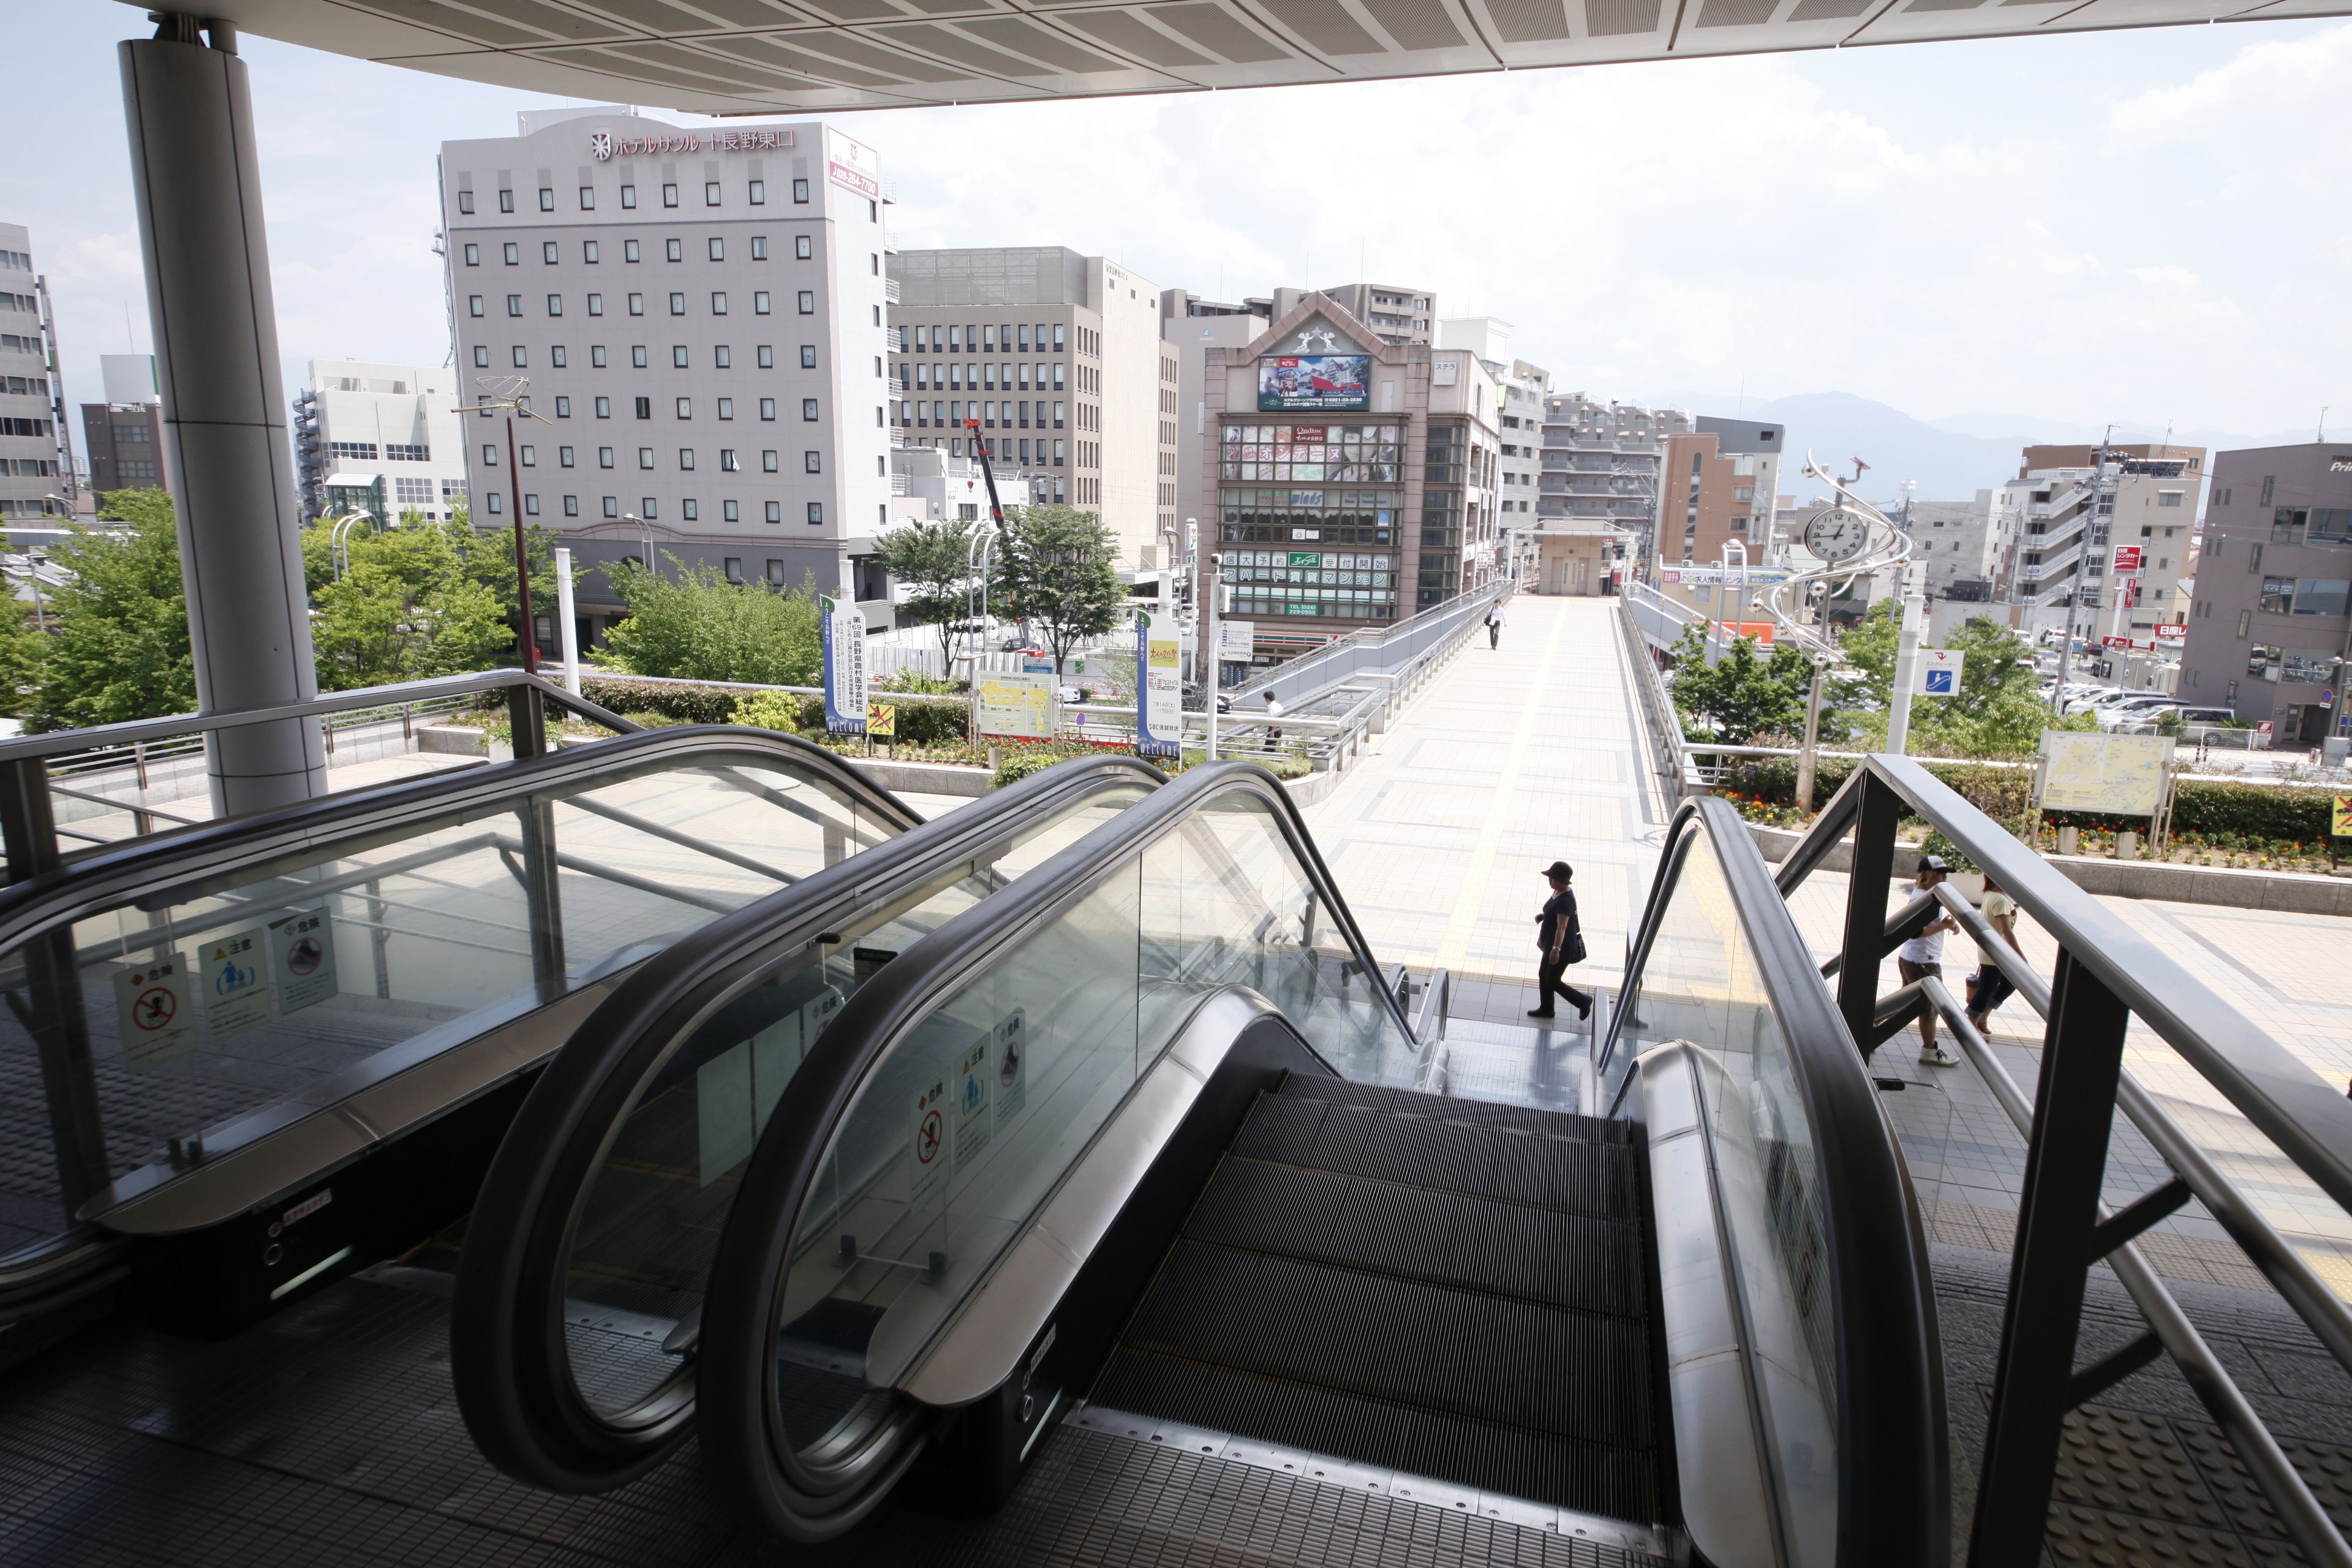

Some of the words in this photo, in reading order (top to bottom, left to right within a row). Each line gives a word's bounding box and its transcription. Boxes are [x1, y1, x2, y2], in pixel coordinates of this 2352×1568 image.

[614, 129, 795, 156] ホテルサンルート長野東口
[837, 168, 876, 194] 026-264-7700
[1260, 445, 1341, 461] オンディーヌ
[1226, 556, 1284, 567] 信大予約
[1291, 554, 1318, 566] エイブル
[1325, 558, 1387, 570] 受付開始
[1224, 569, 1387, 586] アパート賃貸マンション
[852, 616, 862, 638] 第69回
[2160, 625, 2187, 635] 日産レ
[1150, 647, 1177, 659] 大人の文化祭
[828, 722, 864, 733] WELCOME
[1140, 743, 1177, 756] WELCOME
[298, 916, 321, 934] 危険
[228, 938, 252, 956] 注意
[147, 963, 175, 982] 危険
[971, 1045, 985, 1067] 注意
[928, 1082, 944, 1104] 危険
